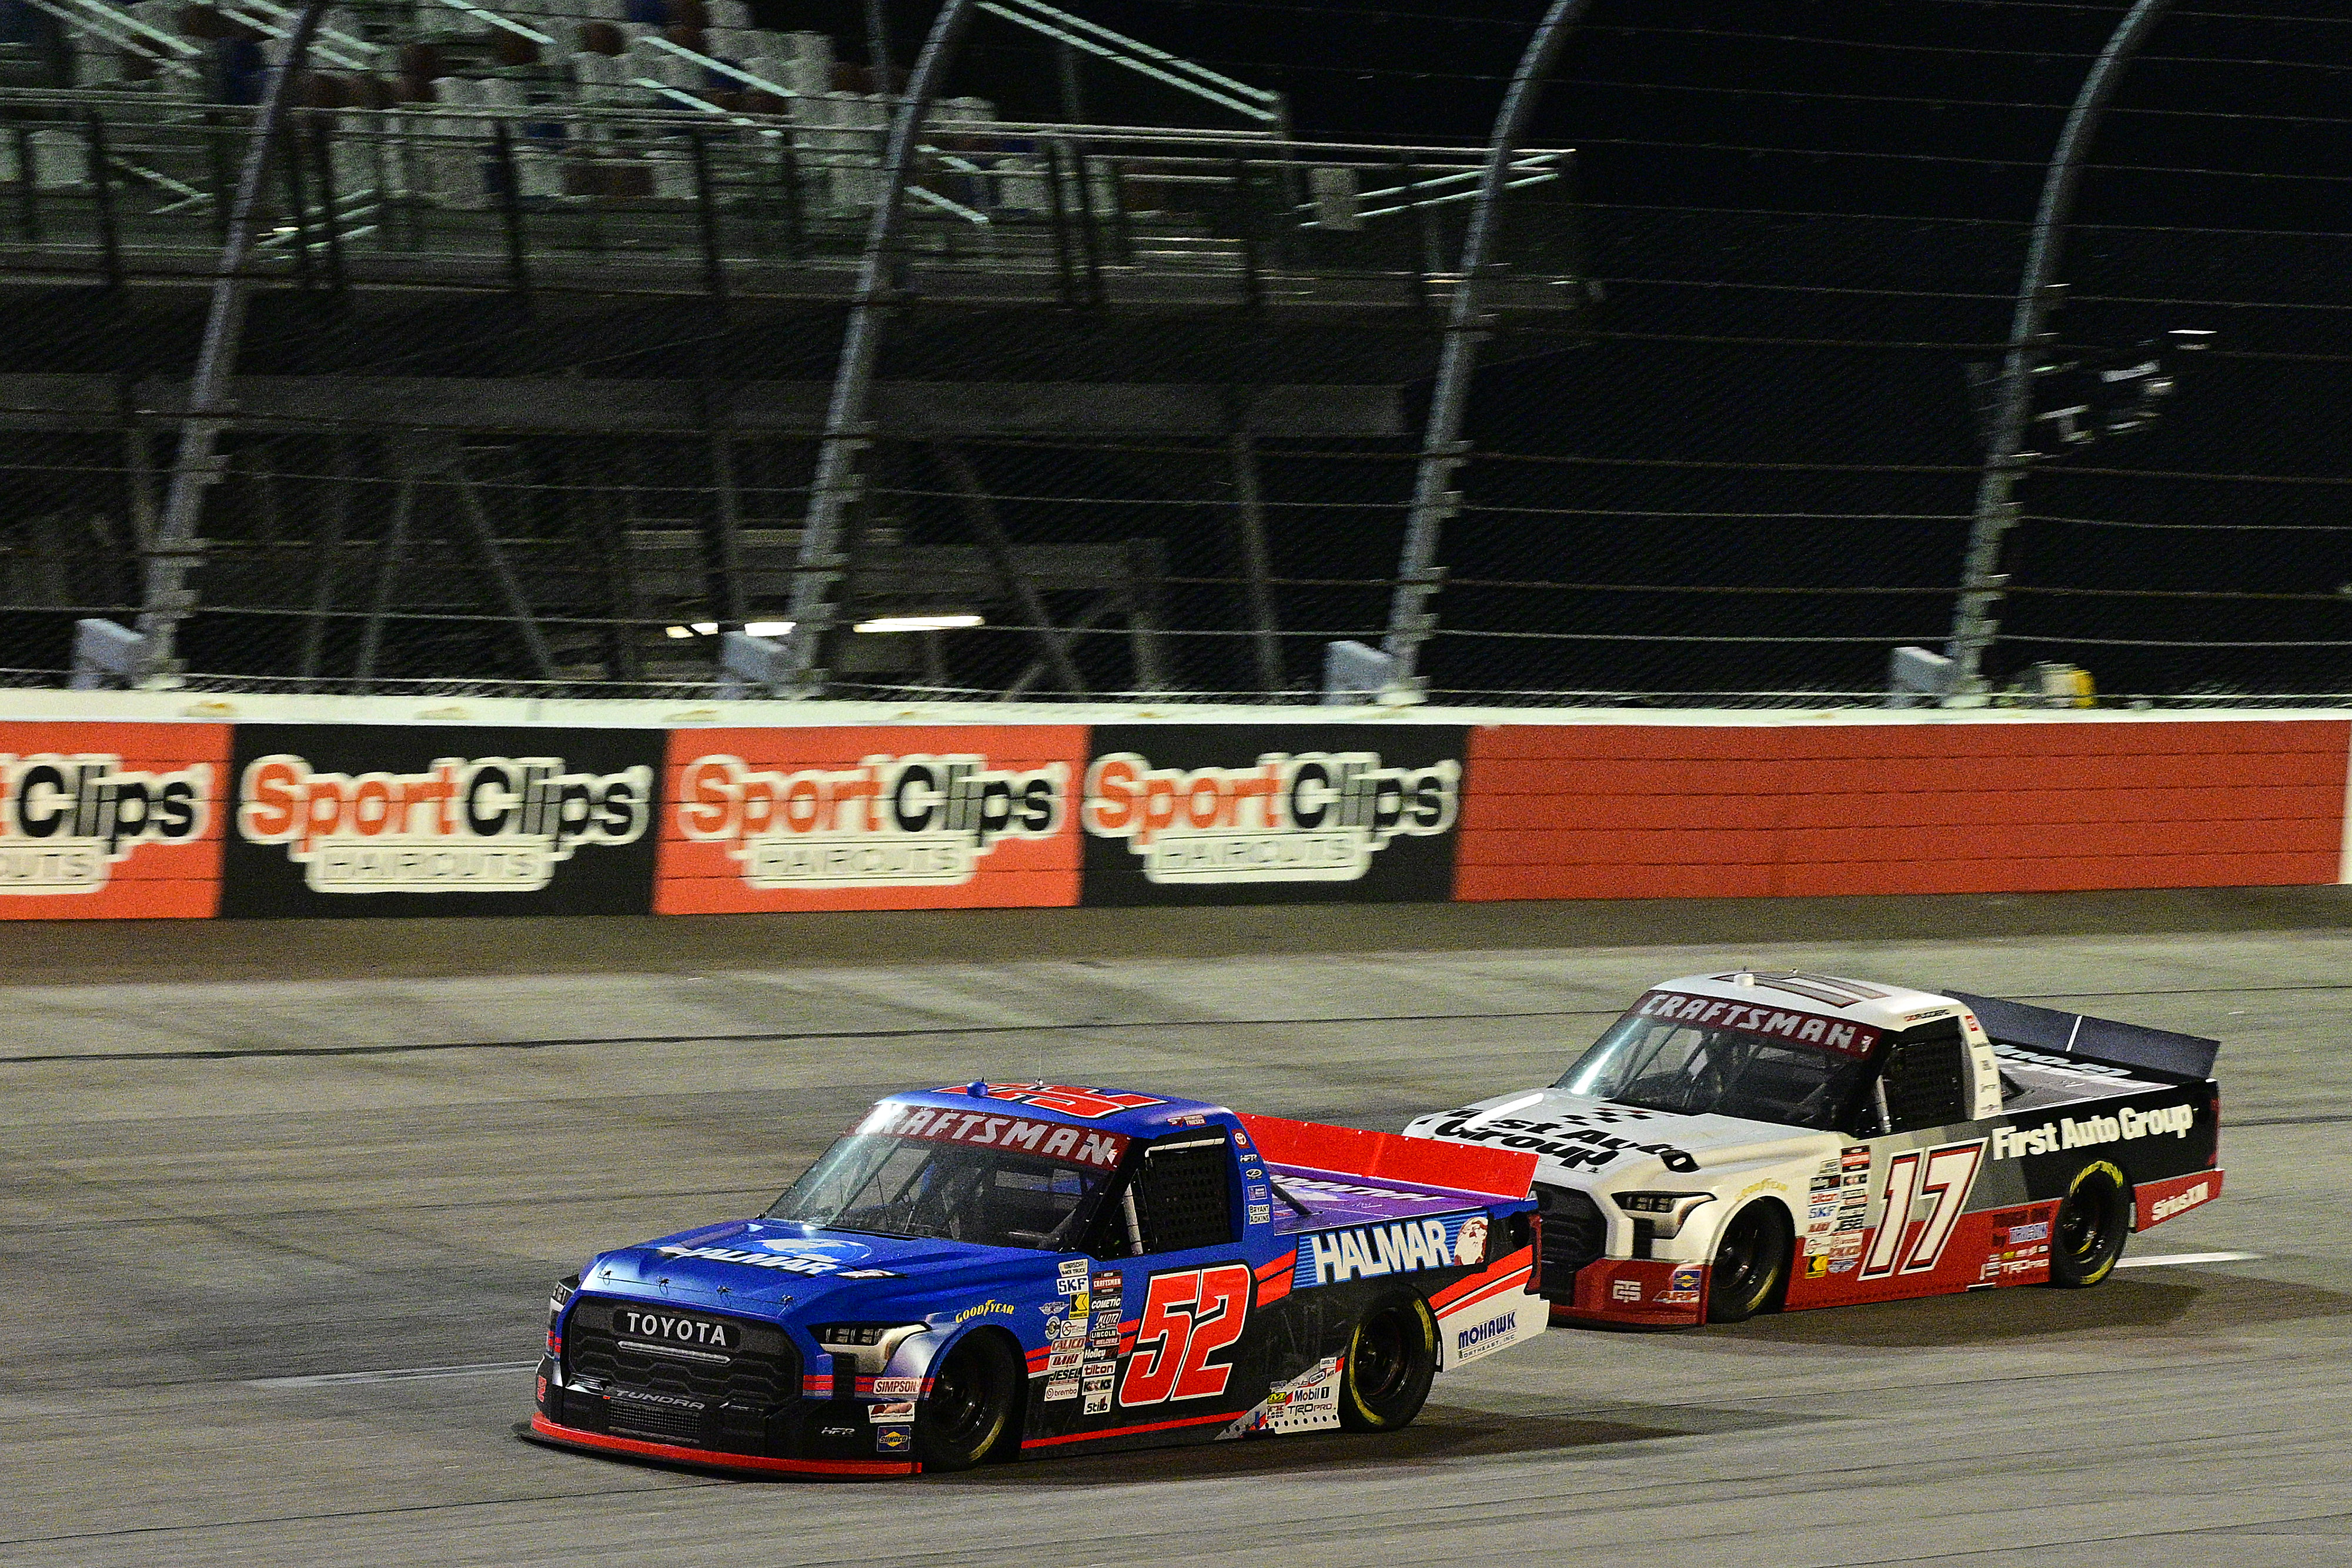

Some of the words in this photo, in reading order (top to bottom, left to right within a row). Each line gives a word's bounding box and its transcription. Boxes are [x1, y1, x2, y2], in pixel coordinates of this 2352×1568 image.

[0, 764, 194, 854] Clips
[1639, 994, 1857, 1049] CRAFTSMAN
[1992, 1122, 2060, 1161] First
[2060, 1115, 2120, 1150] Auto
[2119, 1104, 2194, 1139] Group
[1435, 1118, 1621, 1168] Group
[1250, 1205, 1269, 1213] BRYANT
[1857, 1137, 1989, 1281] 17
[1311, 1220, 1452, 1283] HALMAR
[1058, 1278, 1087, 1293] SKF
[1091, 1298, 1121, 1309] COMETIC
[1098, 1313, 1120, 1324] KLOTZ
[627, 1312, 726, 1346] TOYOTA
[1091, 1330, 1116, 1339] LINCOLN
[1119, 1264, 1250, 1408] 52
[1458, 1311, 1516, 1350] MOHAWK
[1052, 1338, 1085, 1351] CALICO
[1084, 1348, 1106, 1360] Holley
[1050, 1368, 1082, 1382] JESEL
[1084, 1365, 1114, 1375] tilton
[876, 1380, 917, 1393] SIMPSON
[1054, 1388, 1077, 1396] brembo
[616, 1389, 706, 1410] TUNDRA
[1294, 1387, 1319, 1402] Mobil
